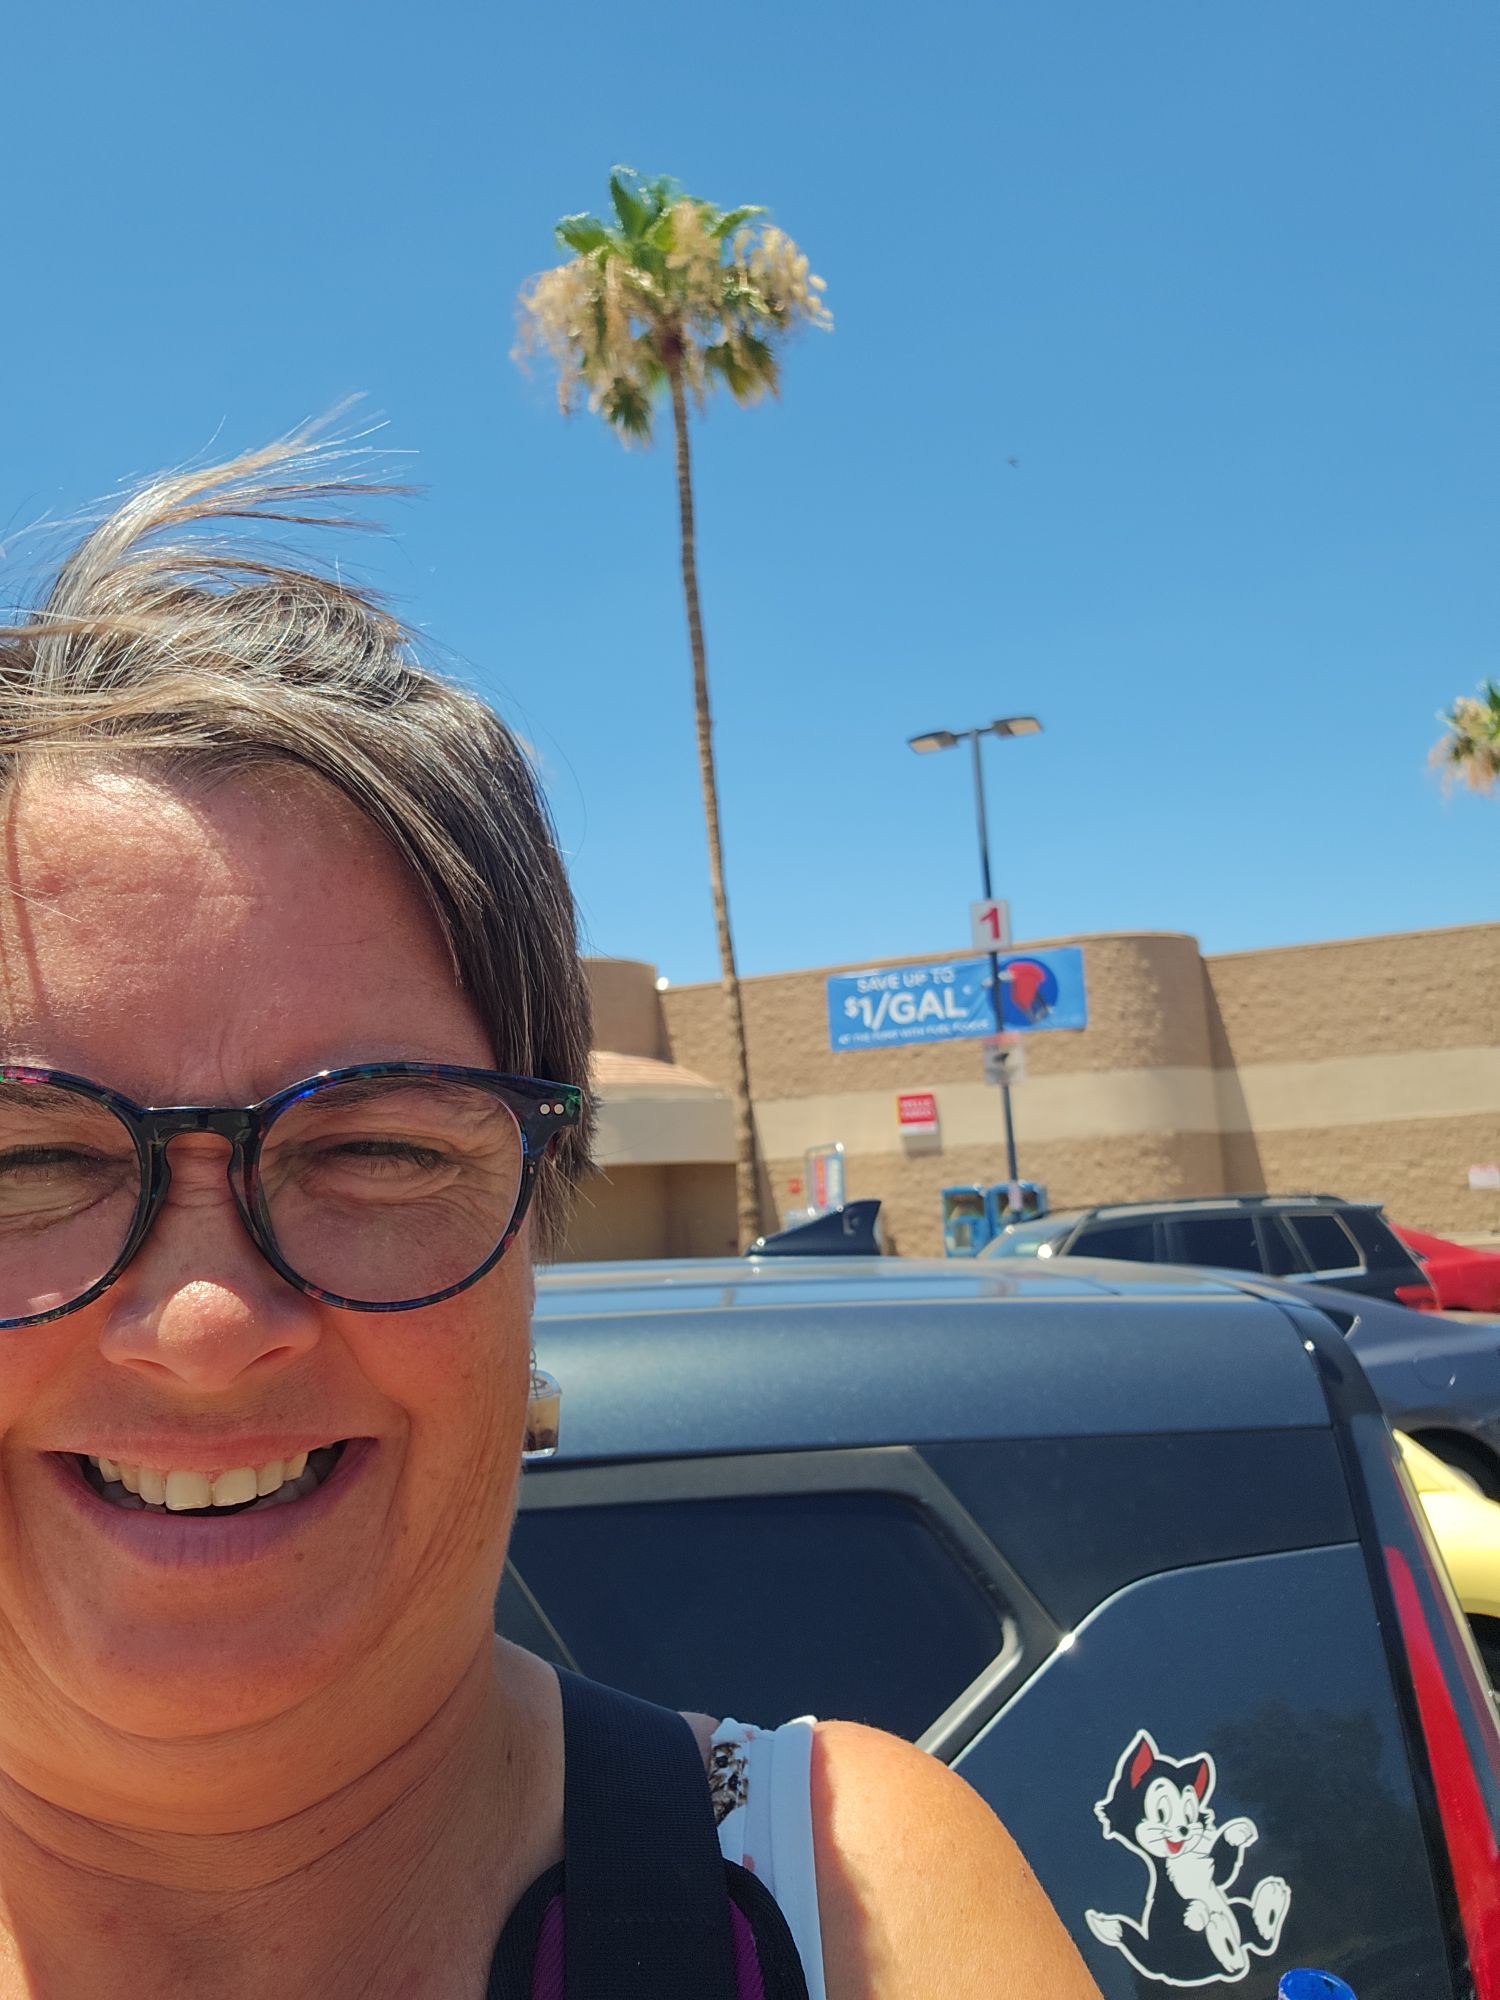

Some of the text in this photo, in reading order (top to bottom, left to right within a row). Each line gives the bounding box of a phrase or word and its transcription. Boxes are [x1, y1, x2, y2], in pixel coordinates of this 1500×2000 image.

[980, 906, 1002, 941] 1
[857, 966, 956, 993] SAVE UP TO
